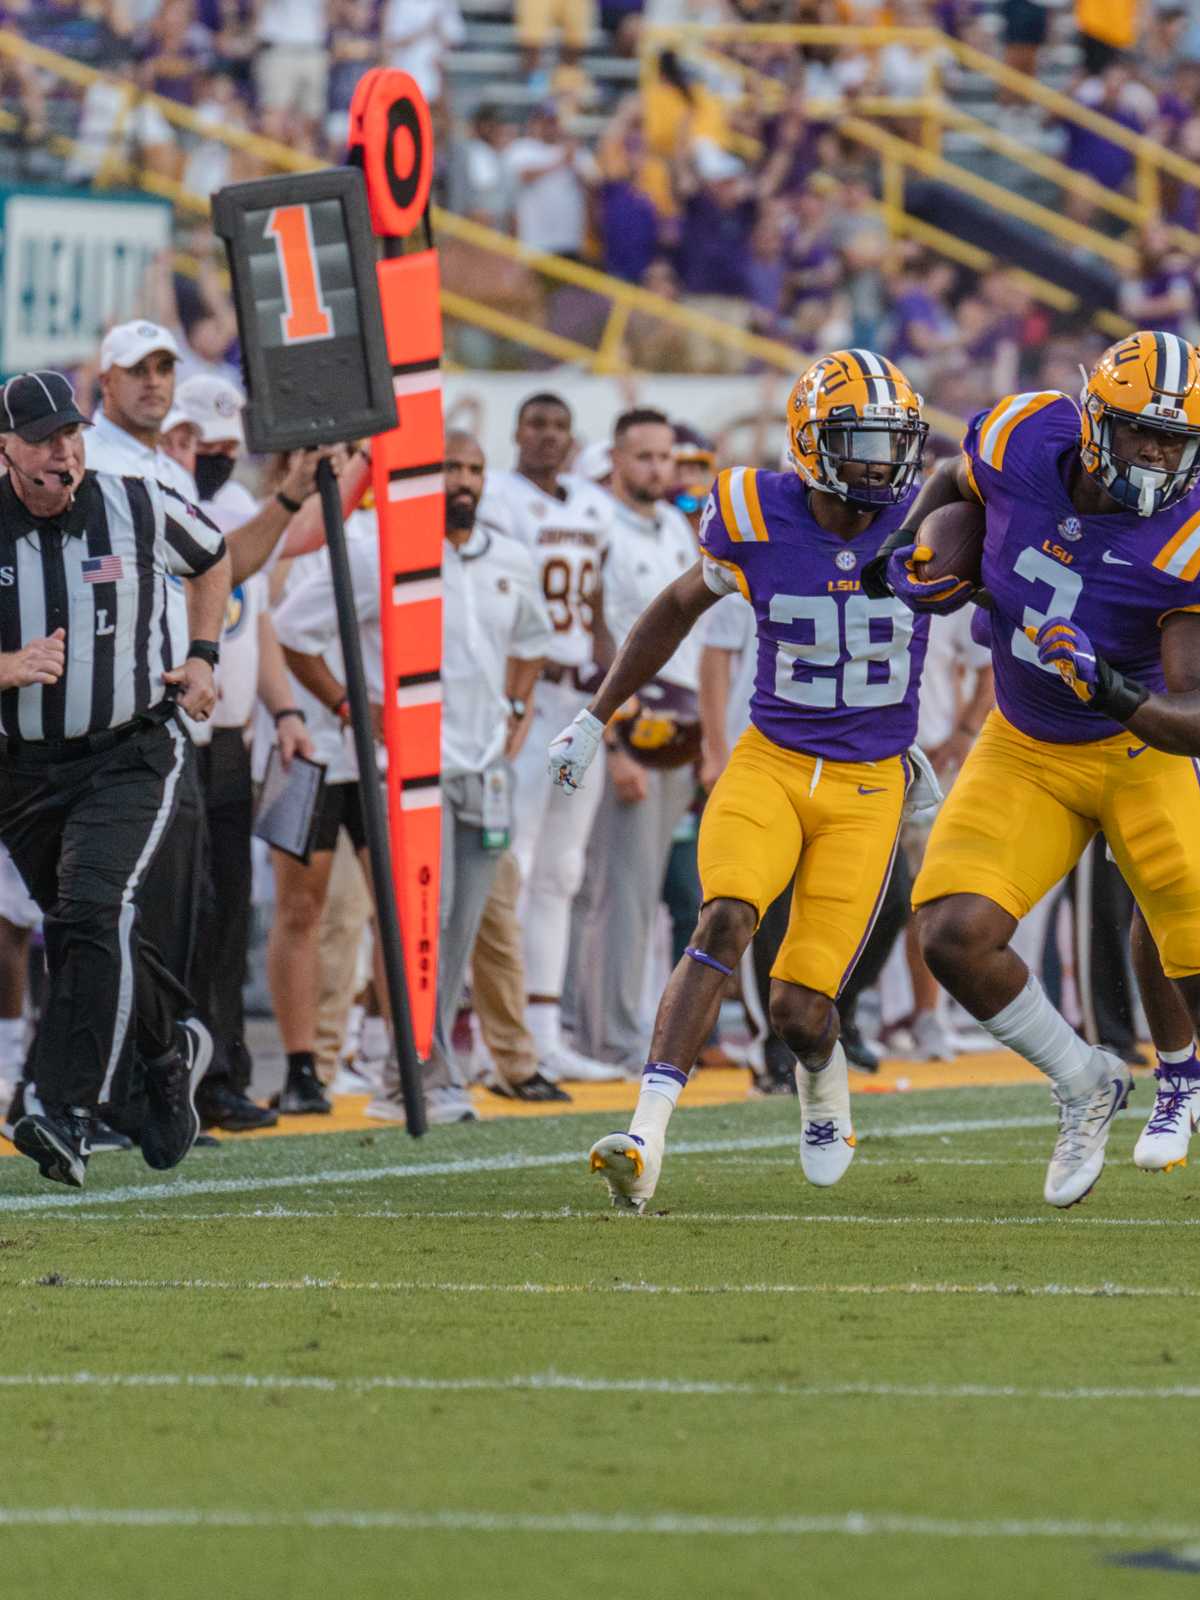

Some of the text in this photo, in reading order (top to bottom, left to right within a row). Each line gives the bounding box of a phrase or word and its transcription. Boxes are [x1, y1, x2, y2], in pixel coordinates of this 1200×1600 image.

[263, 203, 335, 345] 1
[1154, 405, 1180, 419] LSU
[1042, 539, 1073, 564] LSU
[828, 579, 861, 592] LSU
[96, 608, 116, 636] L
[1010, 546, 1084, 676] 3
[769, 593, 914, 708] 28
